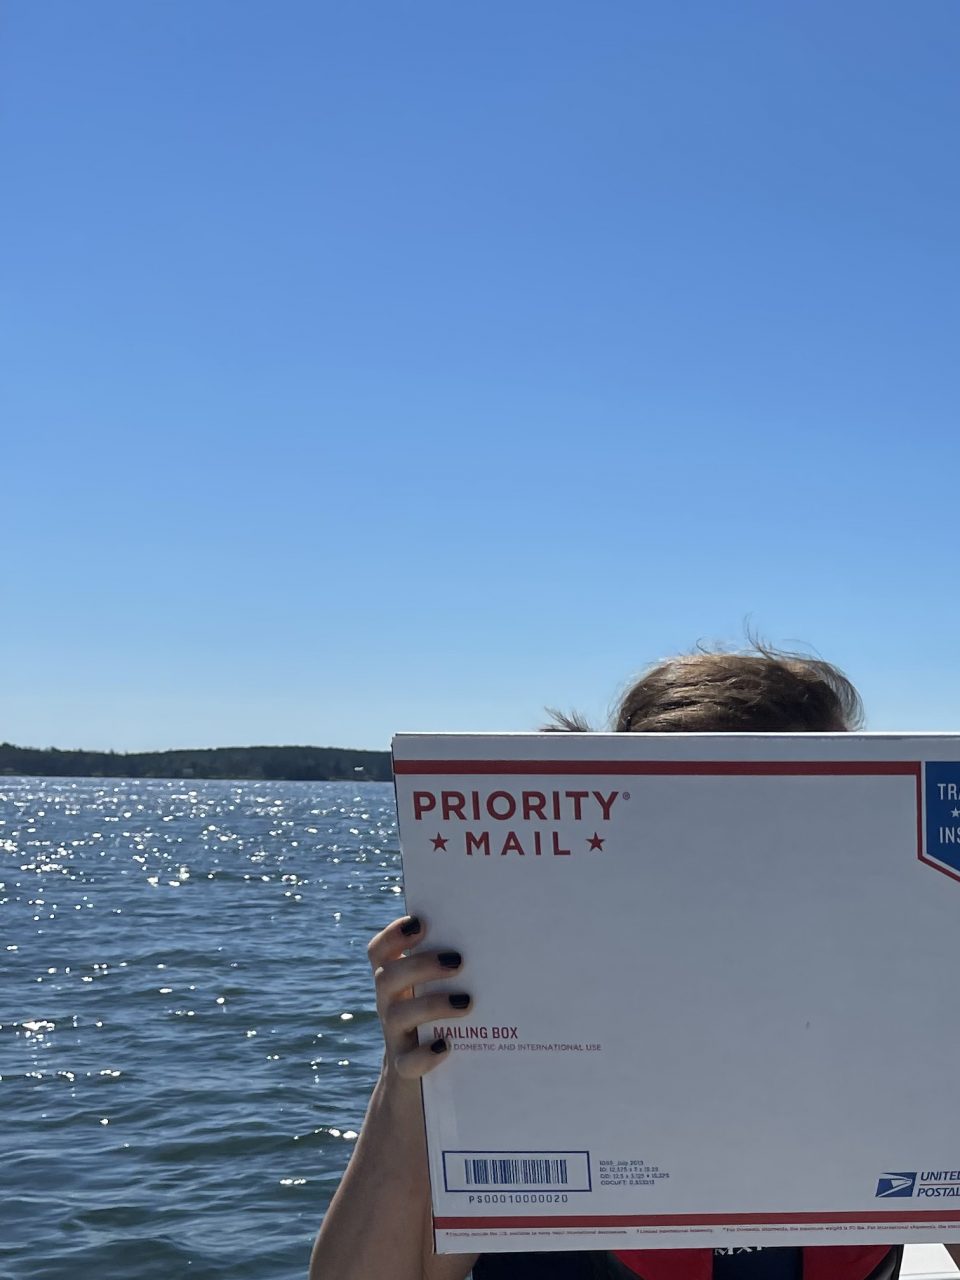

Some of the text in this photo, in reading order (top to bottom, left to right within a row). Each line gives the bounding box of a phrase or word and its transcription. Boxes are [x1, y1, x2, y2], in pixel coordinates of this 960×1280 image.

[464, 831, 572, 856] MAIL
[433, 1026, 519, 1040] MAILING BOX
[453, 1043, 602, 1052] DOMESTIC AND INTERNATIONAL USE
